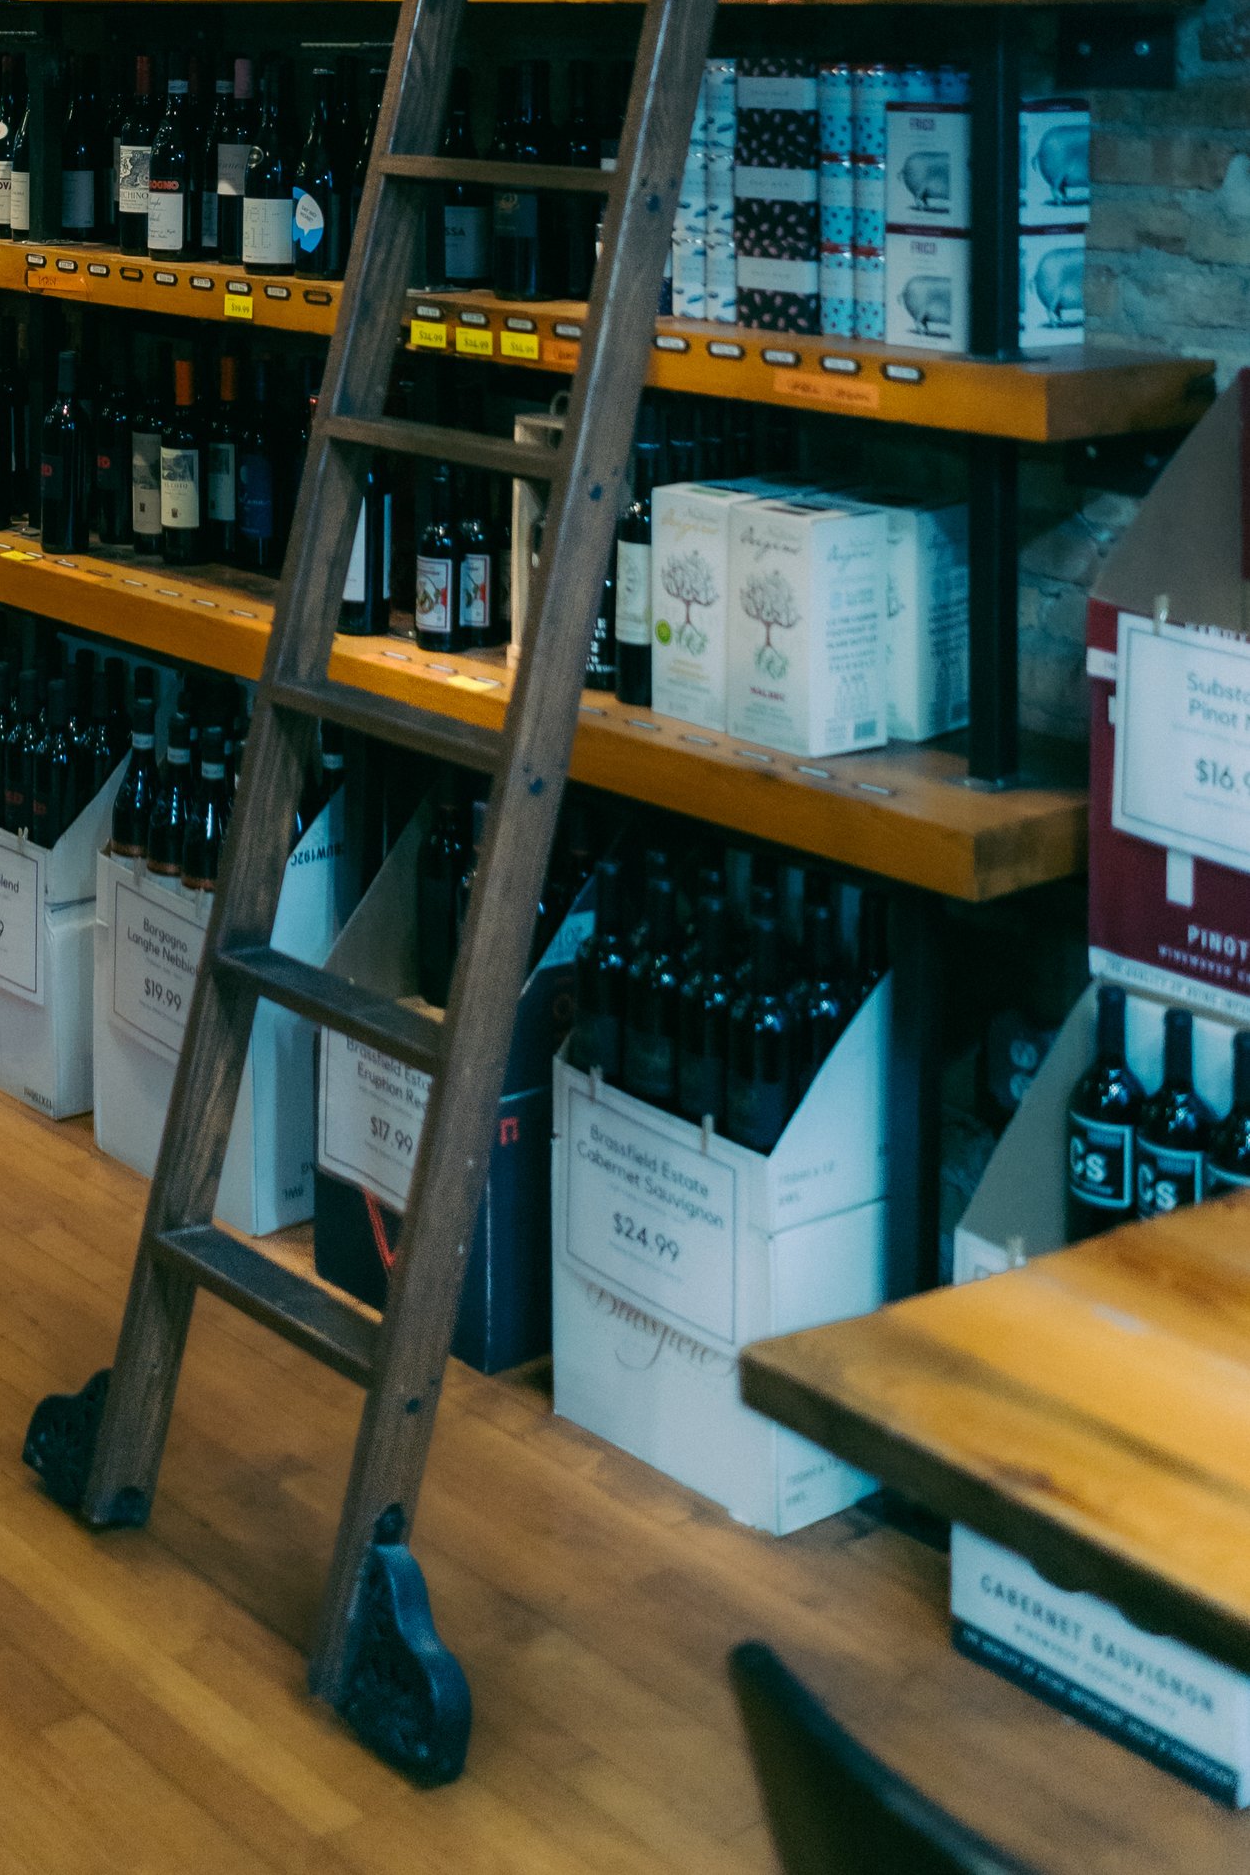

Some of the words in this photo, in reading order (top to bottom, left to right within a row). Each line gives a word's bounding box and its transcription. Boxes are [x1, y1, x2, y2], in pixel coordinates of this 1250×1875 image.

[908, 116, 936, 131] FRICO
[910, 240, 938, 255] FRICO
[1189, 697, 1238, 732] Pinot
[126, 926, 161, 958] Langhe
[142, 916, 189, 954] Borgogno
[1187, 923, 1250, 964] PINOT
[143, 976, 183, 1013] $19.99
[356, 1061, 406, 1098] Eruption
[369, 1116, 415, 1157] $17.99
[589, 1122, 658, 1181] Brassfield
[661, 1154, 710, 1200] Estate
[1070, 1136, 1107, 1183] Cs
[576, 1140, 641, 1192] Cabernet
[643, 1177, 725, 1231] Sauvignon
[612, 1211, 680, 1263] $24.99
[979, 1572, 1084, 1642] CABERNET
[1091, 1632, 1216, 1716] SAUVIGNON
